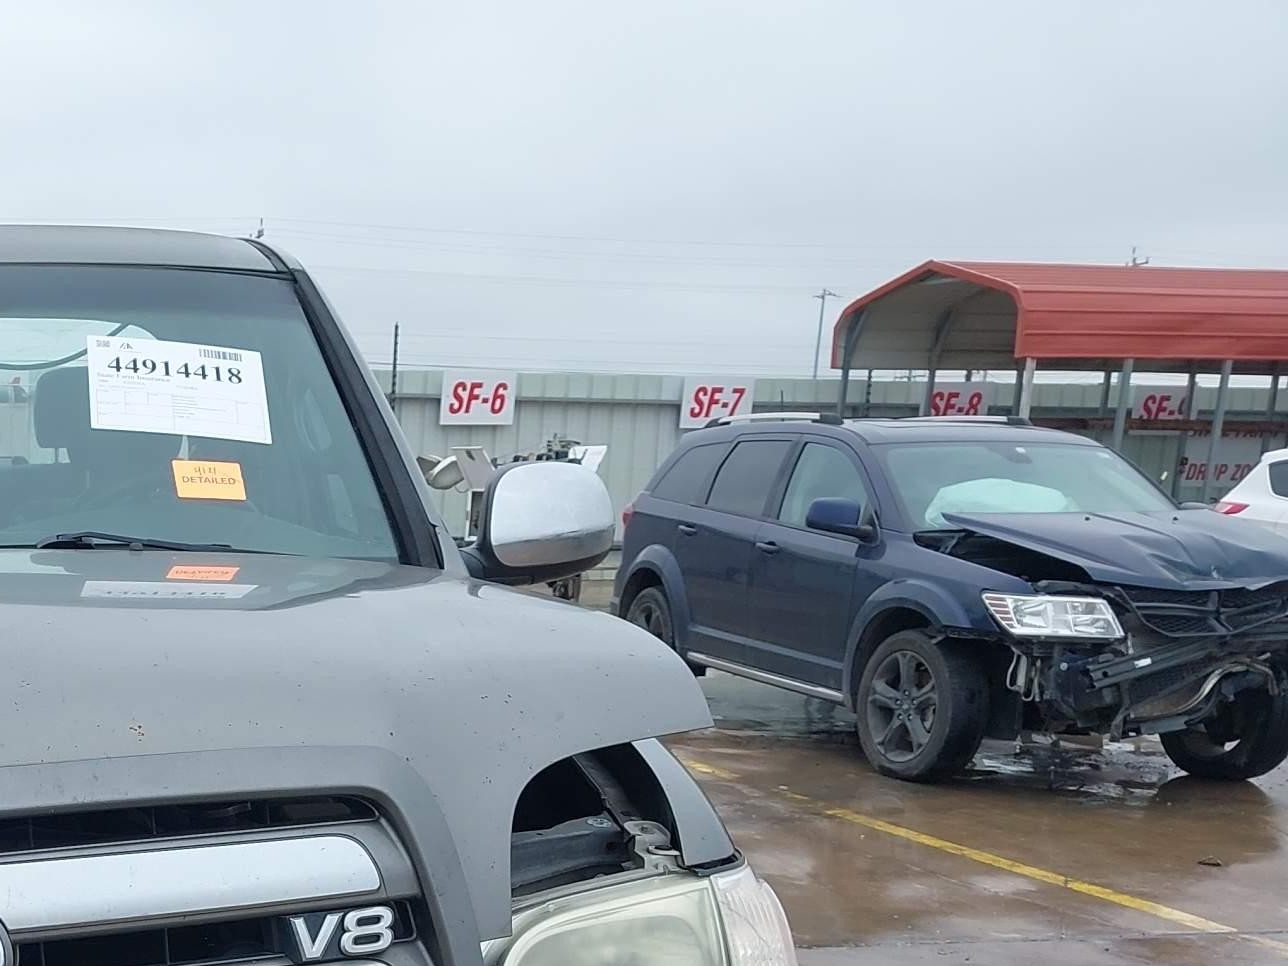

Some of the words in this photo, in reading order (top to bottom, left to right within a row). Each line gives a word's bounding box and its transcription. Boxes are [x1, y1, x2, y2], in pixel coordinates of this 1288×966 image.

[107, 356, 243, 385] 44914418
[449, 381, 508, 415] SF-6
[689, 386, 746, 418] SF-7
[930, 391, 983, 416] SF-8
[182, 475, 236, 485] DETAILED
[1186, 464, 1228, 481] DRP
[290, 906, 394, 961] V8
